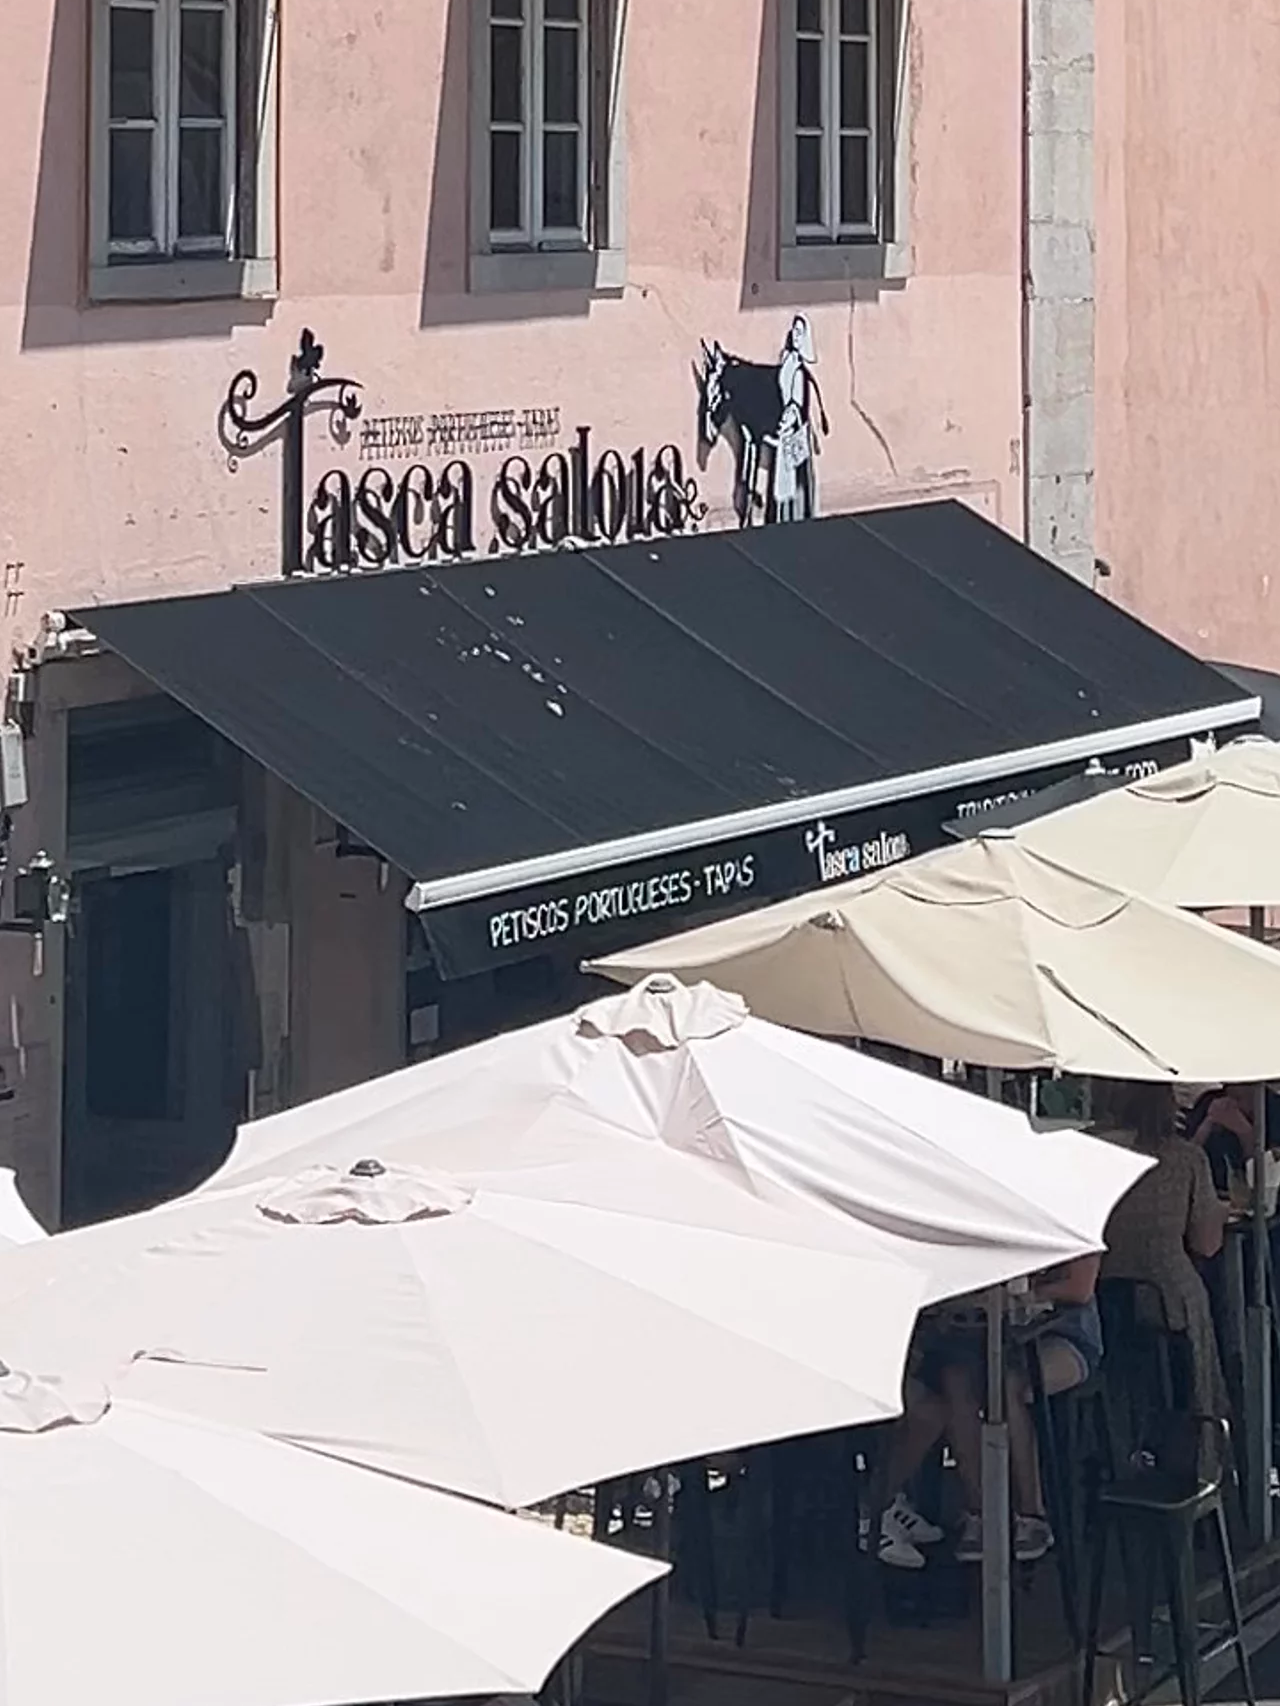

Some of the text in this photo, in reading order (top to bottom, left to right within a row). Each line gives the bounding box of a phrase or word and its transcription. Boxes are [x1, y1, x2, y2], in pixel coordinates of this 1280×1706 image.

[228, 346, 477, 579] Tasca
[489, 897, 570, 948] PETISCOS
[574, 870, 692, 926] PORTUGUESES
